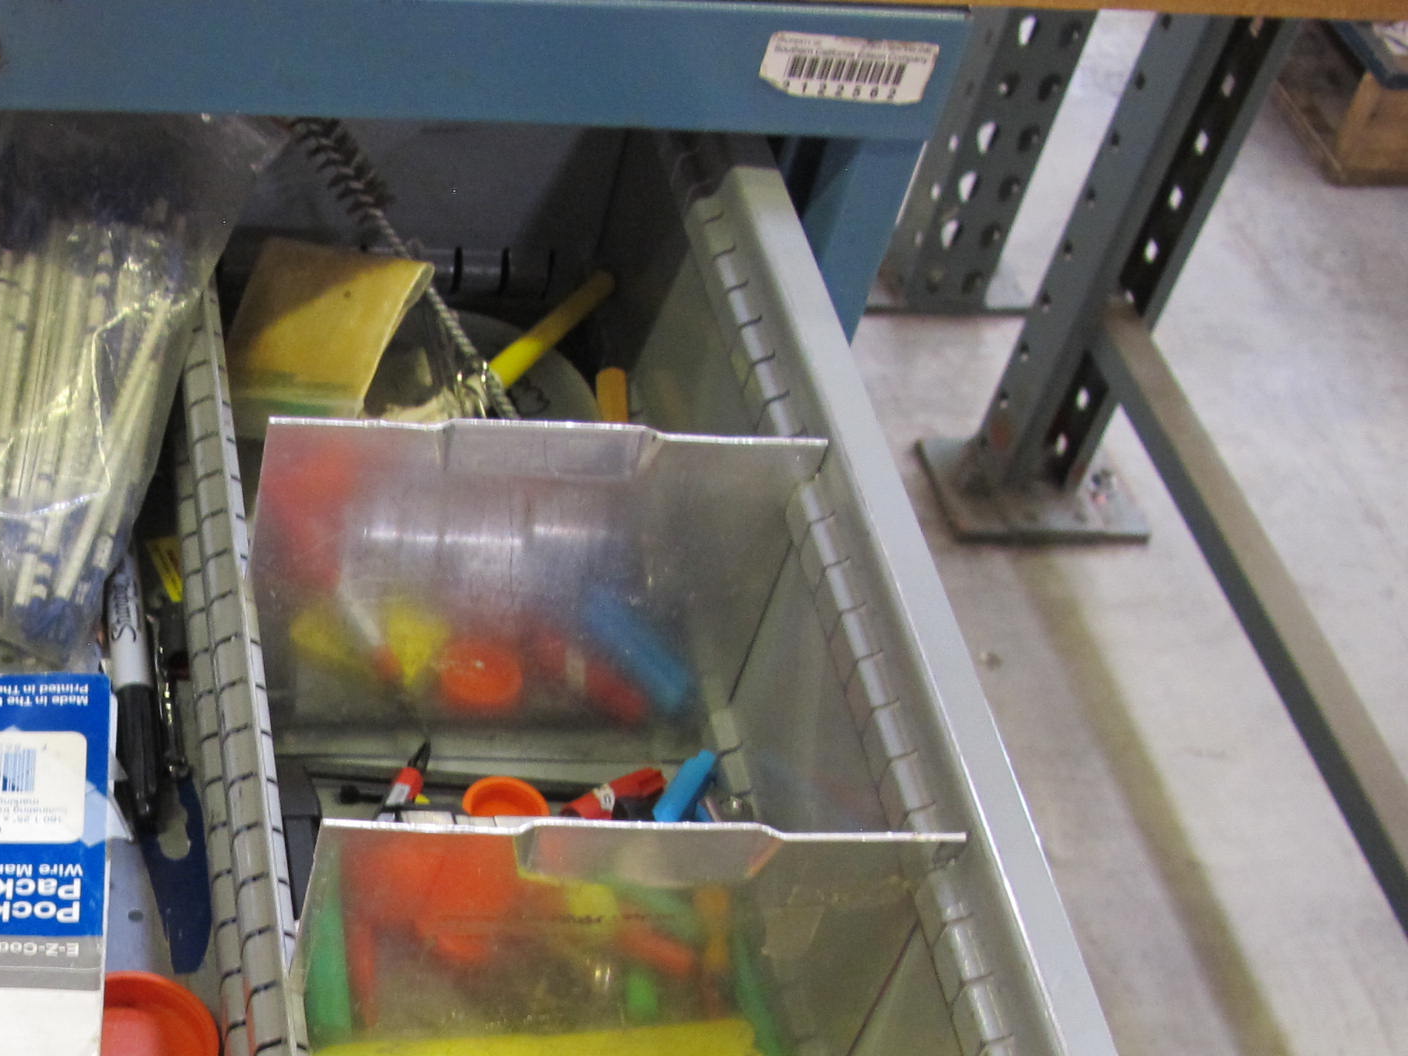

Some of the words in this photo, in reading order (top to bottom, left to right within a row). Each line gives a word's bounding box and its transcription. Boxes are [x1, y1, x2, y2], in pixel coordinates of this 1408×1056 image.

[40, 683, 89, 694] Printed
[7, 696, 32, 706] The
[51, 695, 89, 706] Made
[38, 863, 83, 877] Wire
